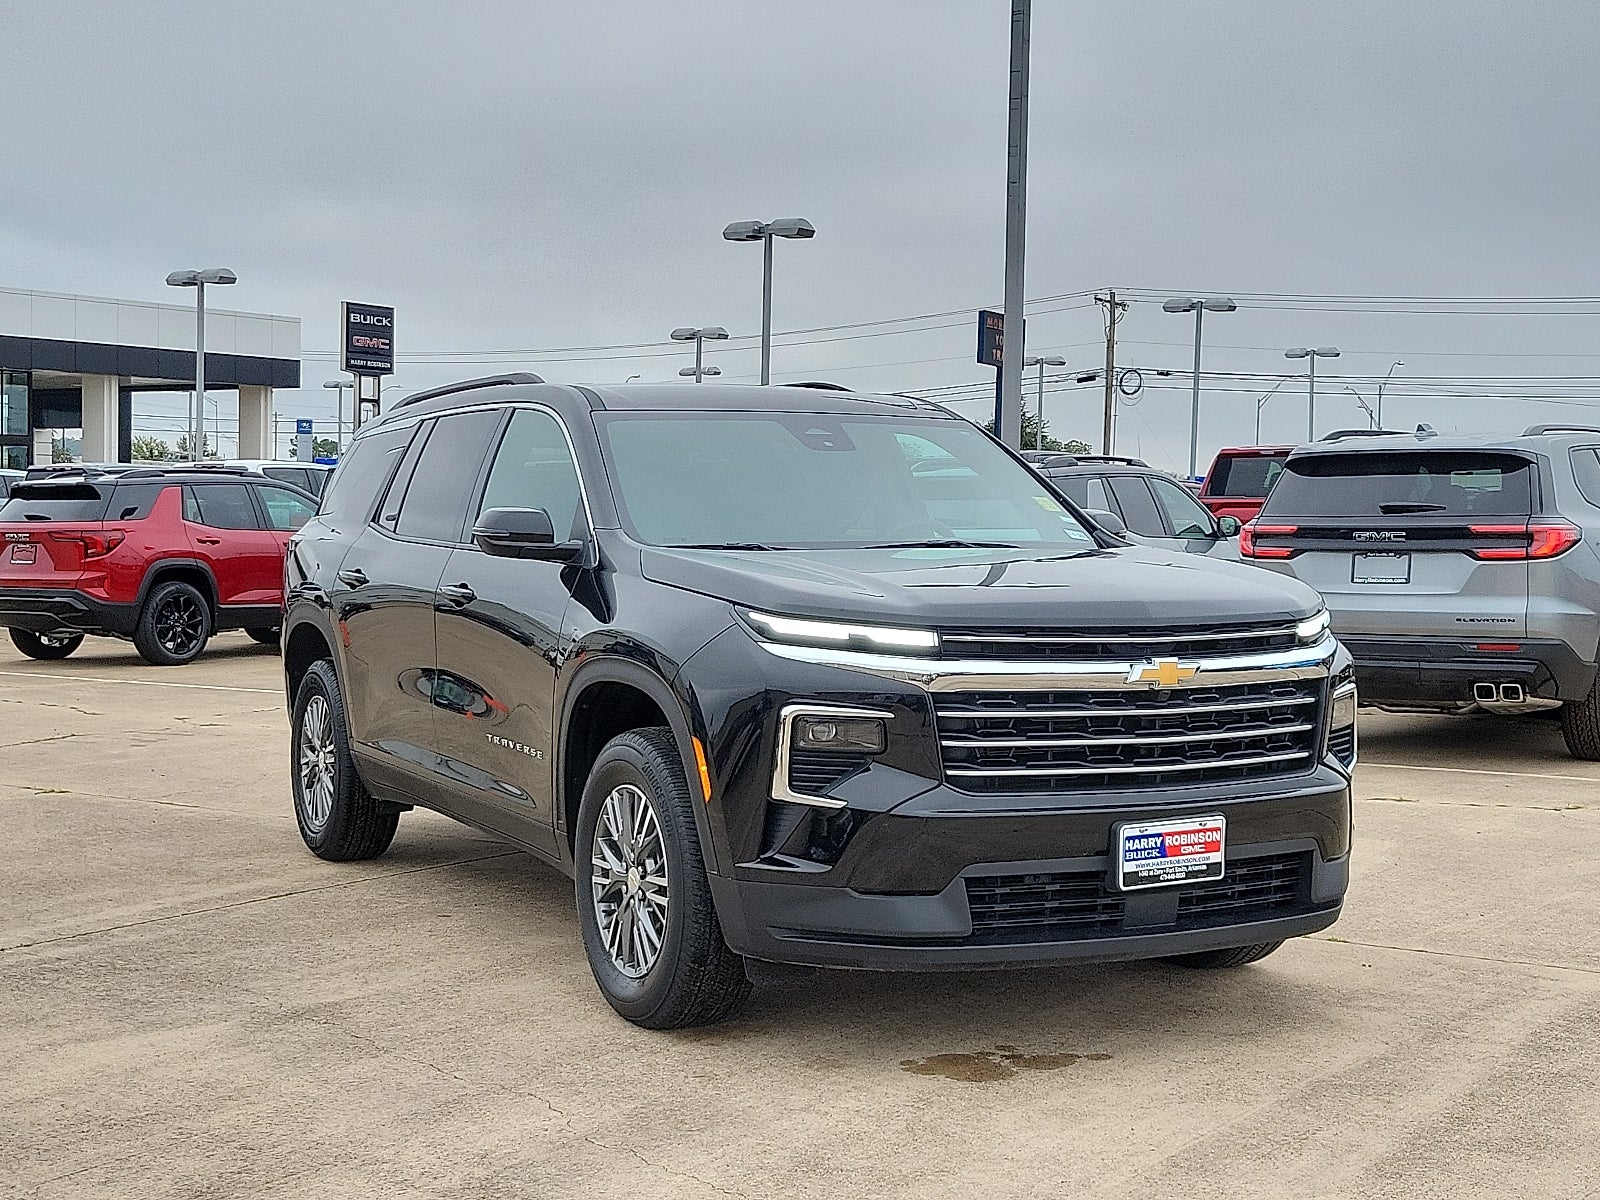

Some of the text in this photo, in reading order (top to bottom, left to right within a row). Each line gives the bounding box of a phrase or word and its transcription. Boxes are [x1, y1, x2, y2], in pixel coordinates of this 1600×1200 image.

[350, 313, 391, 327] BUICK
[353, 335, 390, 350] GMC
[1353, 531, 1406, 542] GMC
[486, 733, 543, 760] TRAVERSE
[1125, 830, 1221, 851] HARRY ROBINSON
[1125, 849, 1161, 860] BUICK
[1181, 844, 1206, 853] GMC
